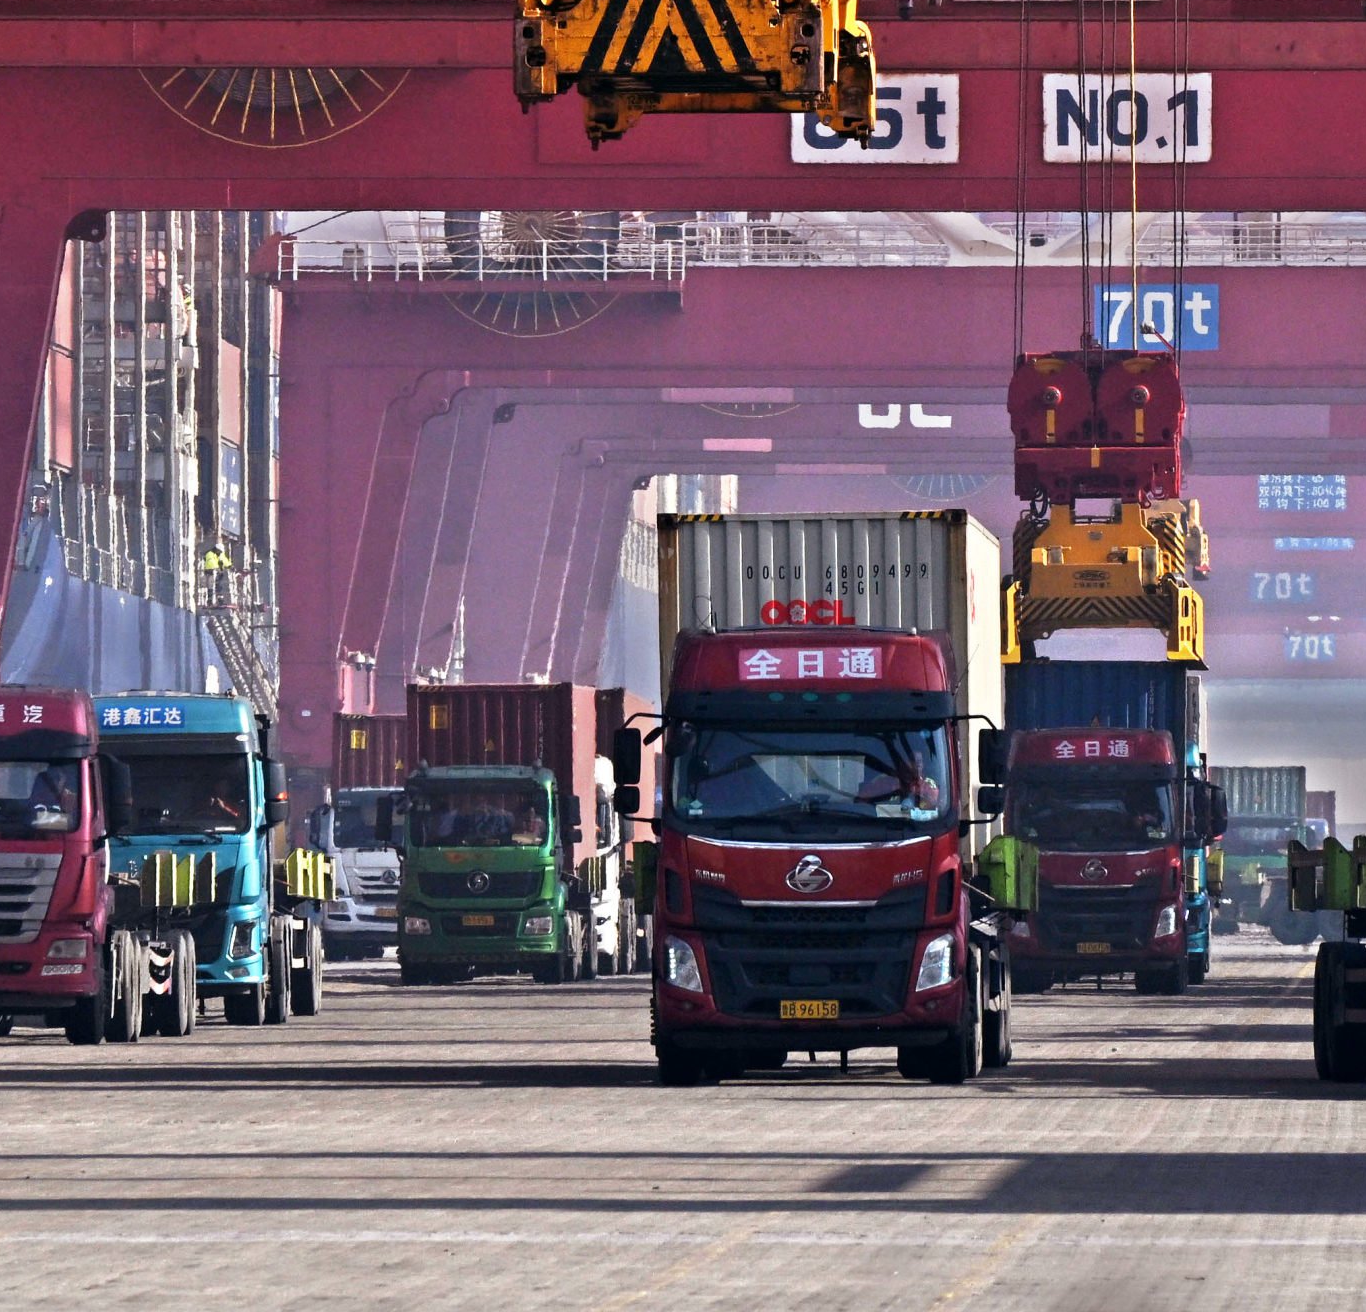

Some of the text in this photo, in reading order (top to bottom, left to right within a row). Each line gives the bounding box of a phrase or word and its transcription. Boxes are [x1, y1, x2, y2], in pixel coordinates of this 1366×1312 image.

[1057, 89, 1199, 147] NO.1
[1108, 292, 1211, 343] 70t
[825, 564, 928, 580] 6809499
[825, 581, 879, 595] 45G1
[1254, 572, 1312, 600] 70t
[761, 599, 856, 625] OOCL
[1289, 634, 1334, 660] 70t
[744, 648, 877, 680] 全日通
[103, 707, 182, 726] 港鑫汇达
[1055, 740, 1129, 759] 全日通
